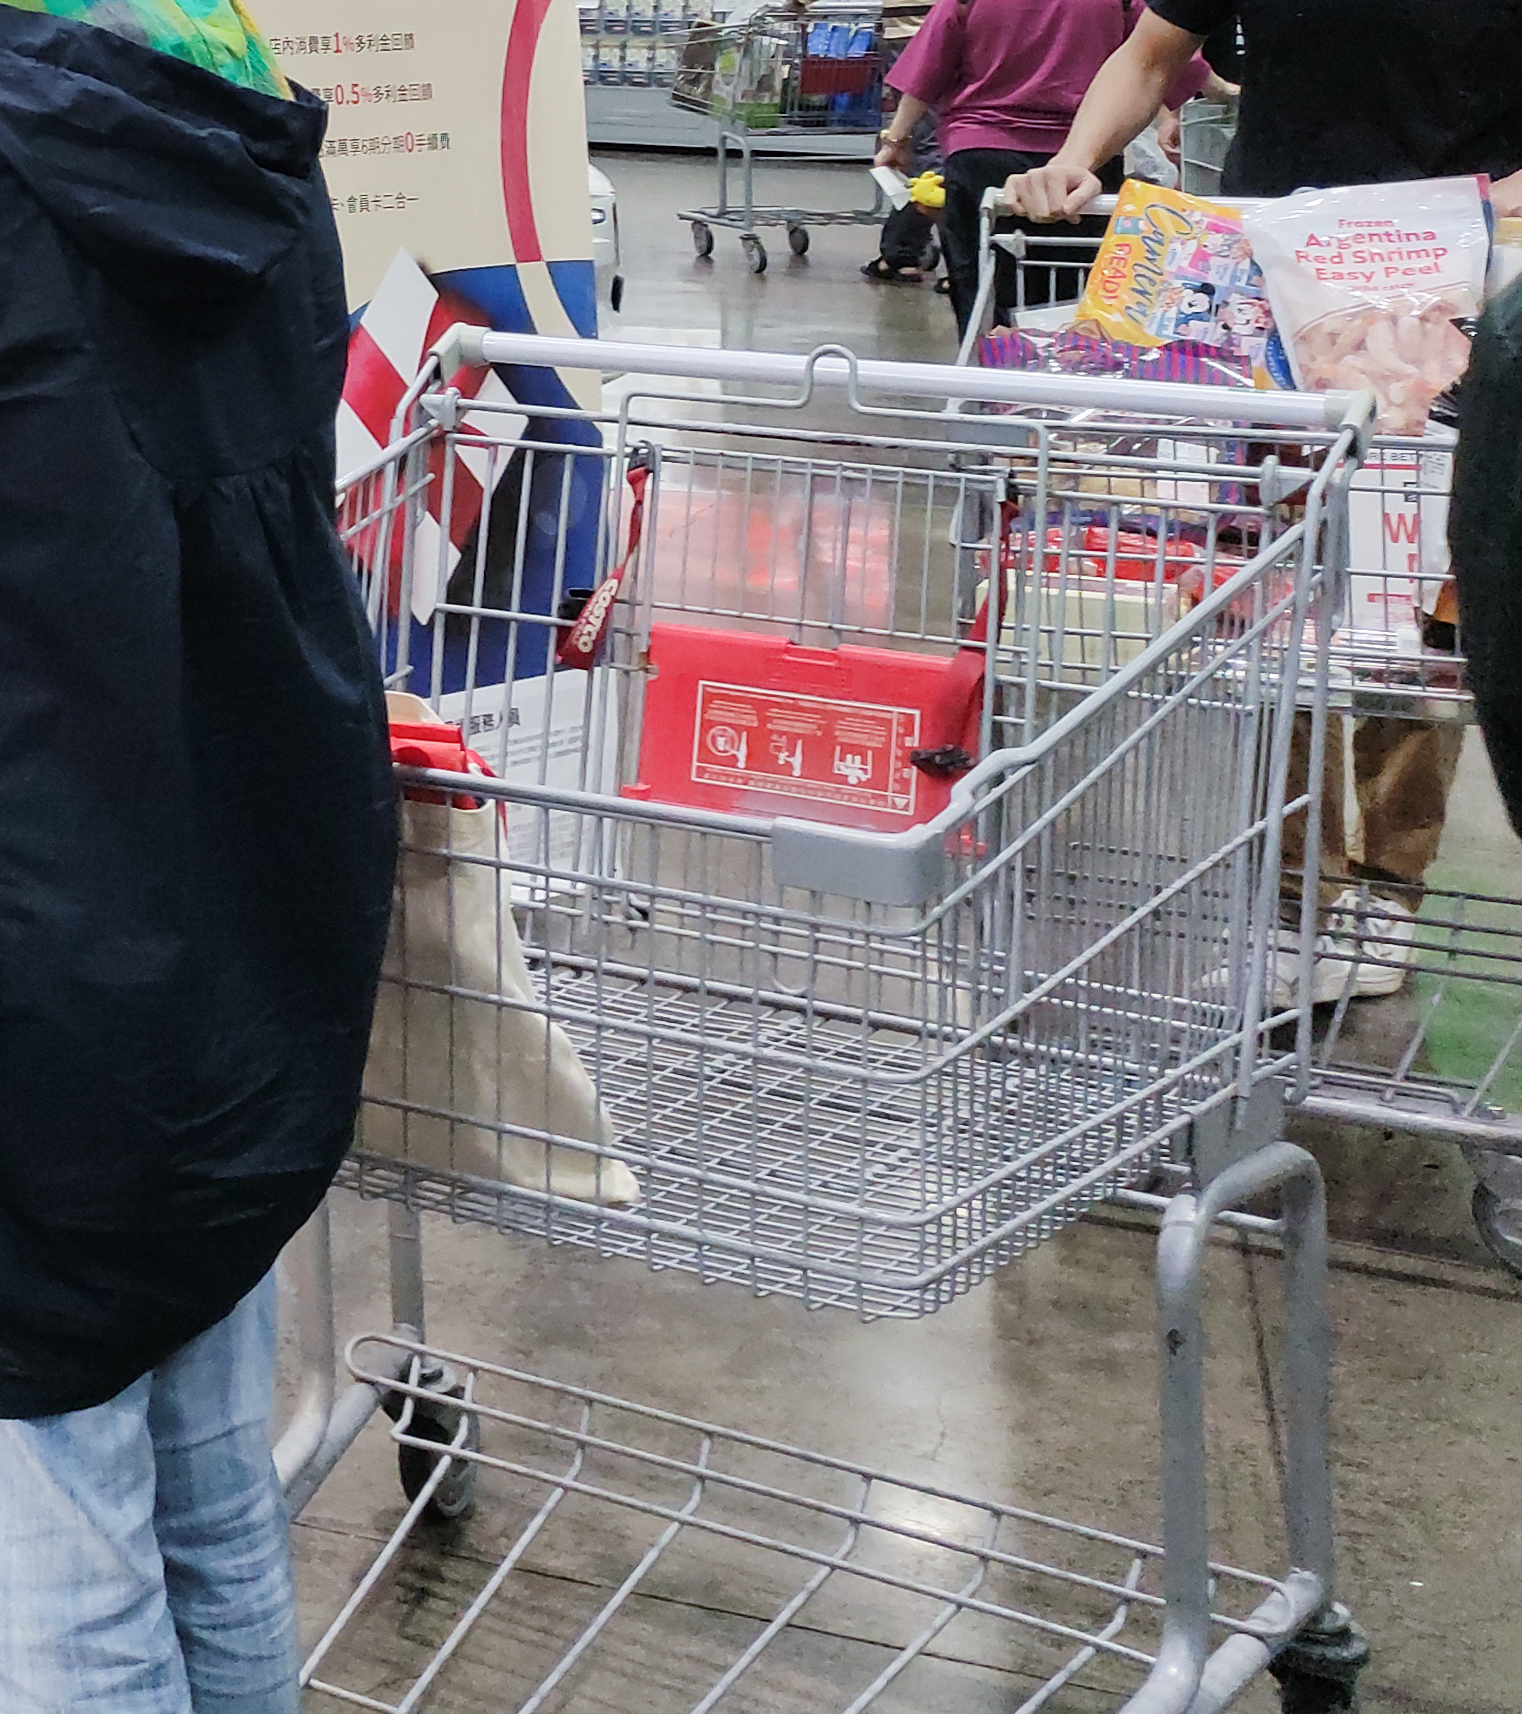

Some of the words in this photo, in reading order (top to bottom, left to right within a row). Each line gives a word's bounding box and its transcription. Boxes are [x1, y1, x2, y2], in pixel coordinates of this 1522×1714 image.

[1337, 217, 1394, 230] Frozen
[1305, 228, 1438, 250] Argentina
[1295, 249, 1346, 267] Red
[1351, 244, 1449, 268] Shrimp
[1314, 266, 1375, 285] Easy
[1383, 261, 1445, 281] Peel
[578, 577, 619, 653] COSTCO
